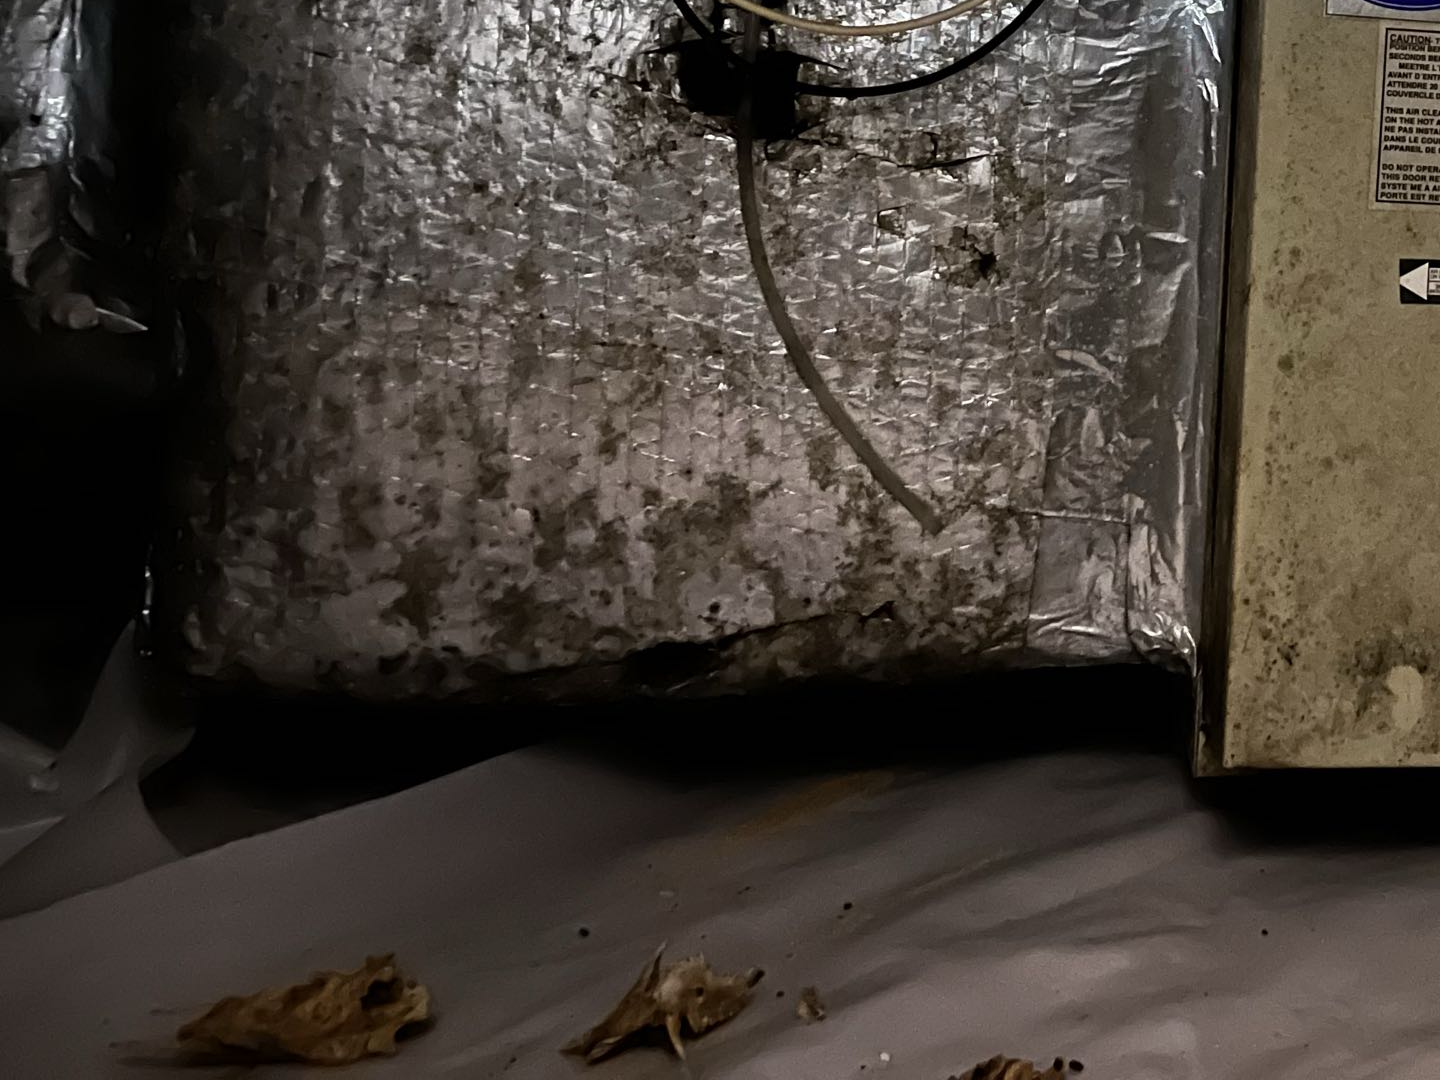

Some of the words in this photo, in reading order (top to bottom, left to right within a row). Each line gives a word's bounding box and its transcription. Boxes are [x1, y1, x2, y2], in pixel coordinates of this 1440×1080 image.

[1388, 53, 1426, 61] SECONDS
[1387, 71, 1412, 79] AVANT
[1387, 81, 1428, 89] ATTENDRE
[1386, 90, 1434, 99] COUVERCLE
[1383, 144, 1423, 153] APPAREIL
[1424, 146, 1436, 154] DE
[1402, 174, 1427, 182] DOOR
